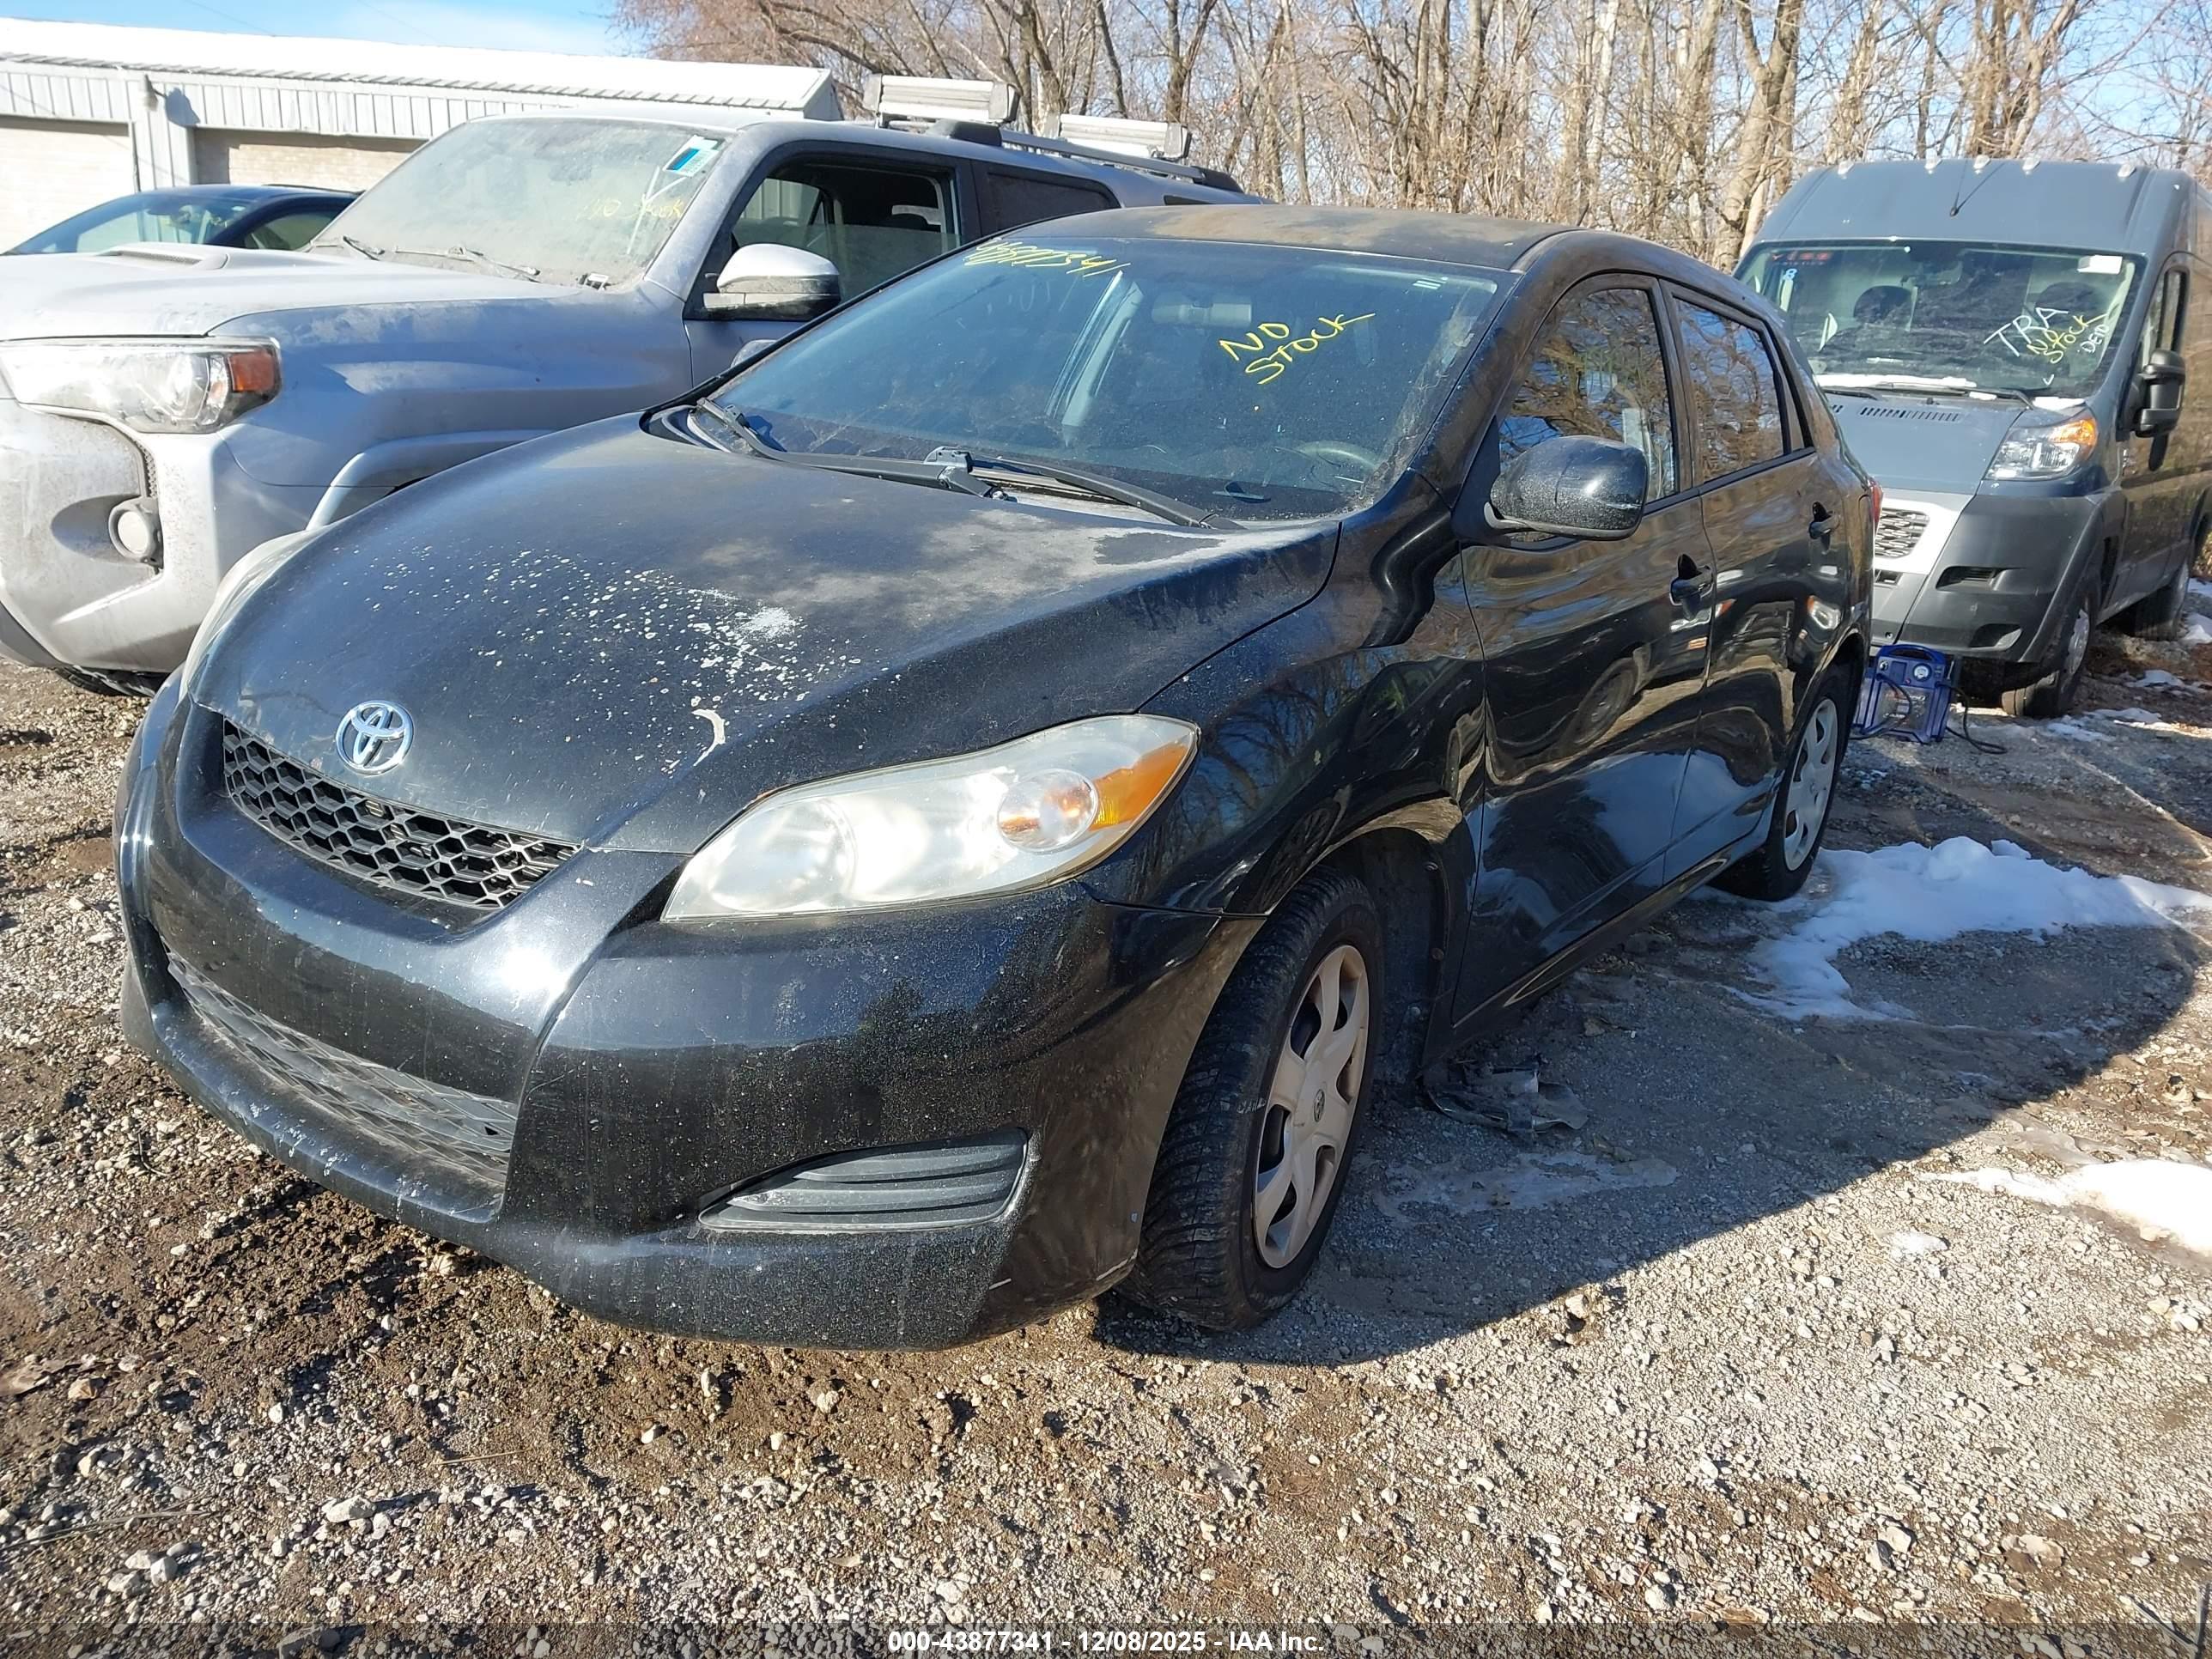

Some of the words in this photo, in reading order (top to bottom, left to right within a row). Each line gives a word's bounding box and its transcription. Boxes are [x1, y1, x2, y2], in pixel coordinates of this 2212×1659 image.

[1218, 322, 1291, 362] NO
[1244, 313, 1376, 385] STOCK
[1984, 307, 2070, 357] TRA
[2043, 314, 2109, 364] STOCK
